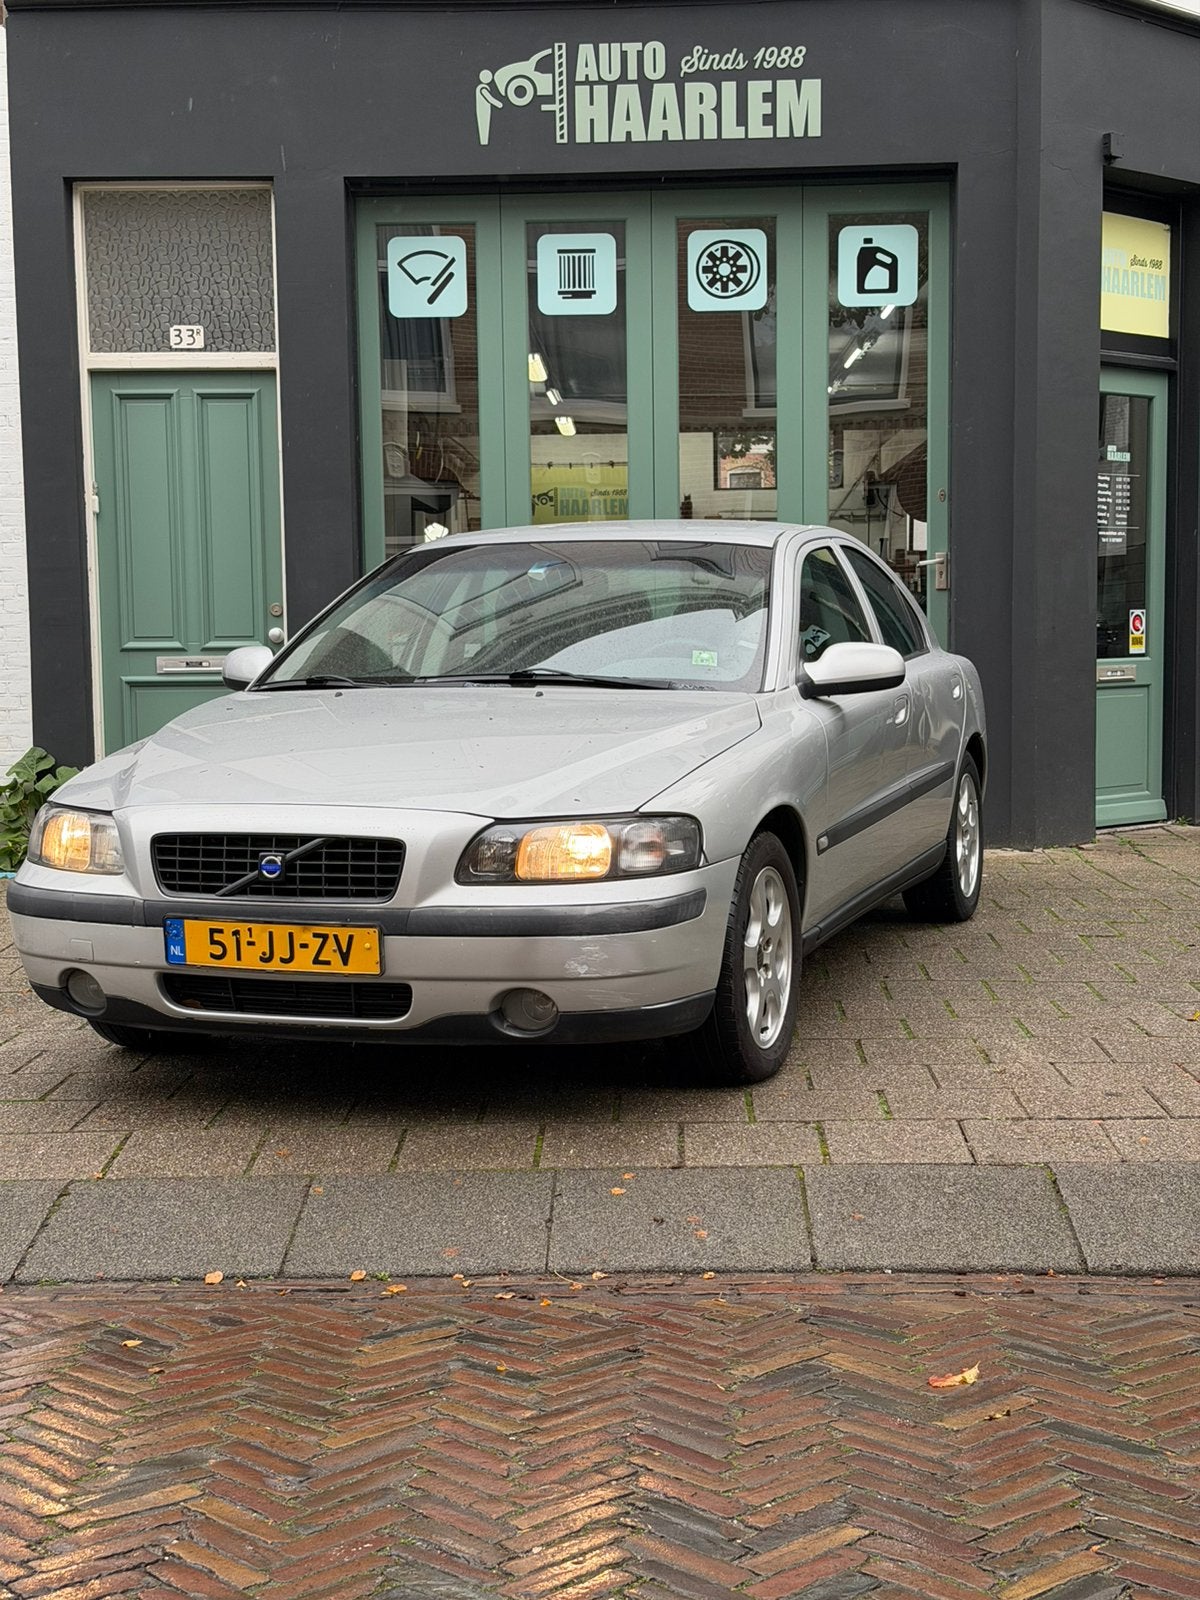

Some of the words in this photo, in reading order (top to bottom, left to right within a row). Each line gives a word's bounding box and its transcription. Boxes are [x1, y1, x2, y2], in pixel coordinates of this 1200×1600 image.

[575, 41, 667, 82] AUTO
[680, 45, 749, 78] Sinds
[753, 45, 807, 69] 1988
[574, 78, 822, 143] HAARLEM
[1130, 254, 1148, 267] Sinds
[1102, 266, 1166, 301] HAARLEM
[170, 944, 184, 956] NL
